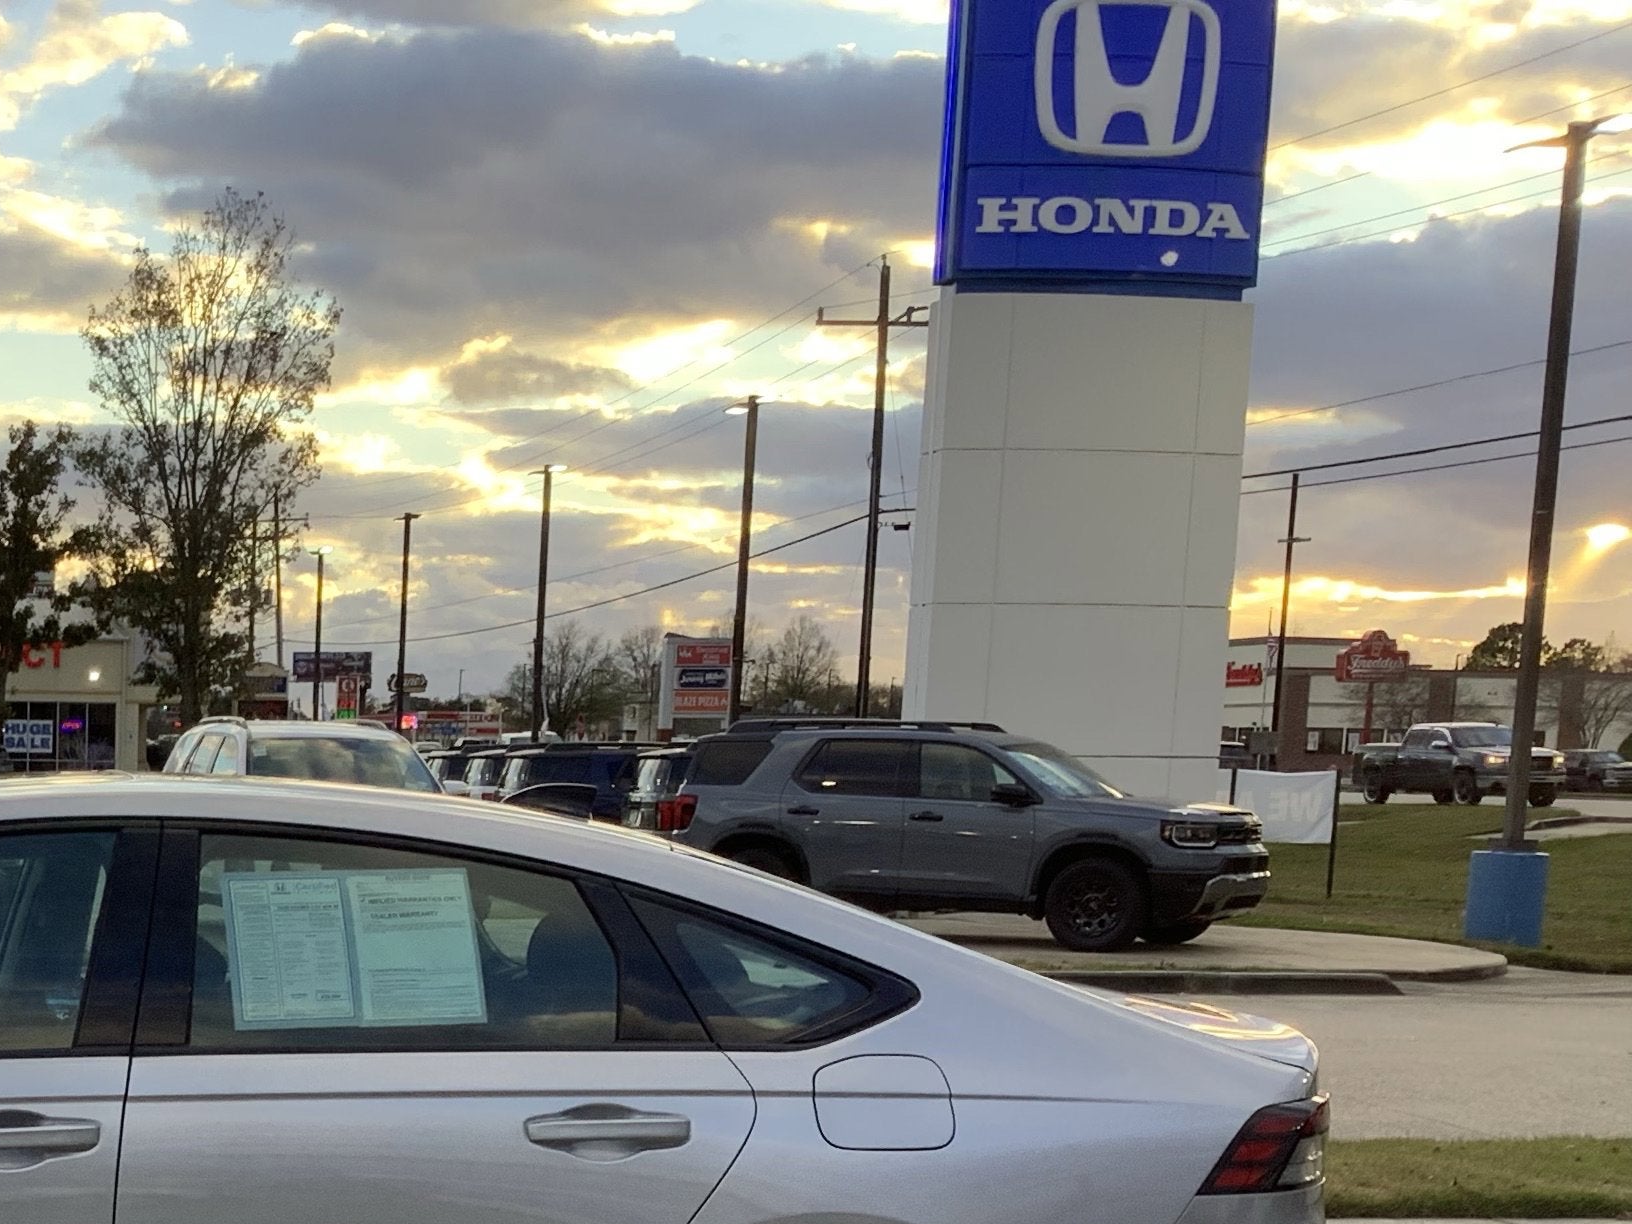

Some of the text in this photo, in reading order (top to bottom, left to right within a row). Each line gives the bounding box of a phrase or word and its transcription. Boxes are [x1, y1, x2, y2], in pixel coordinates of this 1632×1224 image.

[975, 195, 1250, 241] HONDA
[1346, 654, 1405, 670] Freddy's
[698, 696, 719, 707] PIZZA
[5, 722, 52, 735] HUGE
[5, 736, 51, 749] SALE
